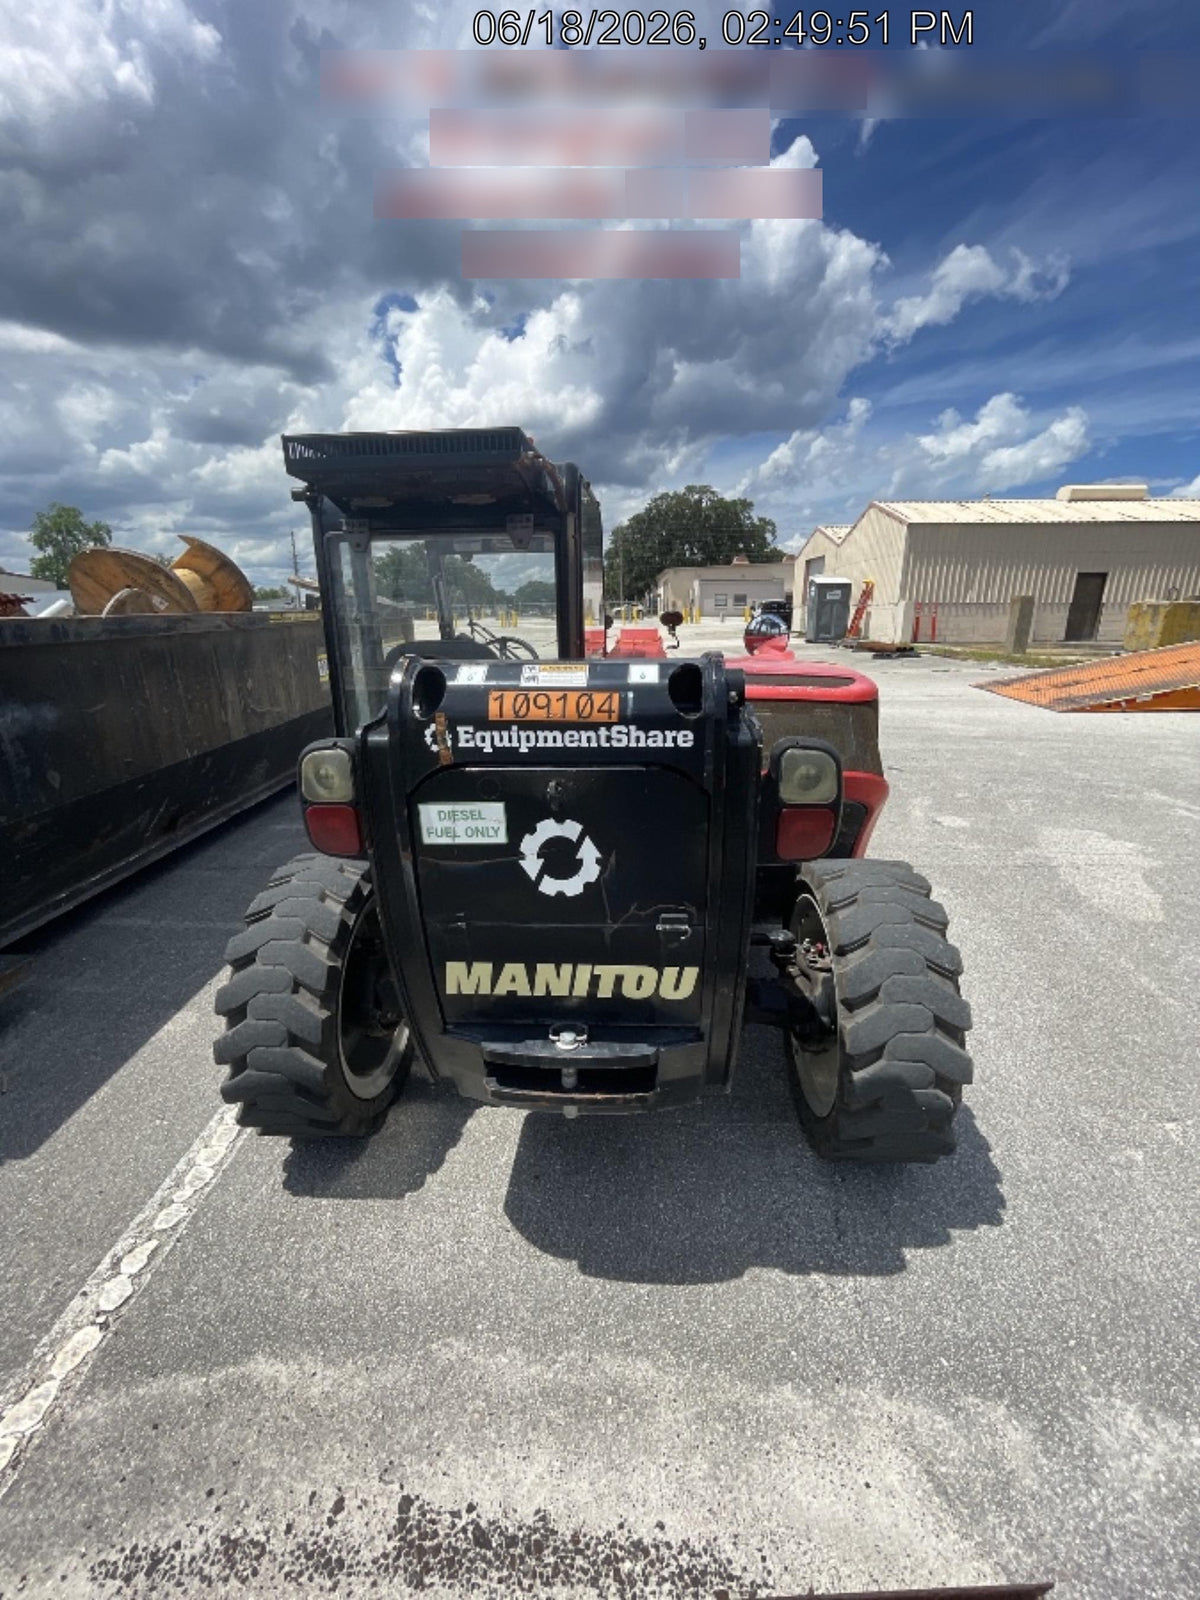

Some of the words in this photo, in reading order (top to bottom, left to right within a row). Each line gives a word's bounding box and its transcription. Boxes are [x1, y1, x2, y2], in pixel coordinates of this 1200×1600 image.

[492, 692, 616, 720] 109104
[456, 725, 694, 752] EquipmentShare
[437, 810, 486, 822] DIESEL
[426, 825, 461, 838] FUEL
[464, 825, 500, 838] ONLY
[445, 961, 699, 1000] MANITOU
